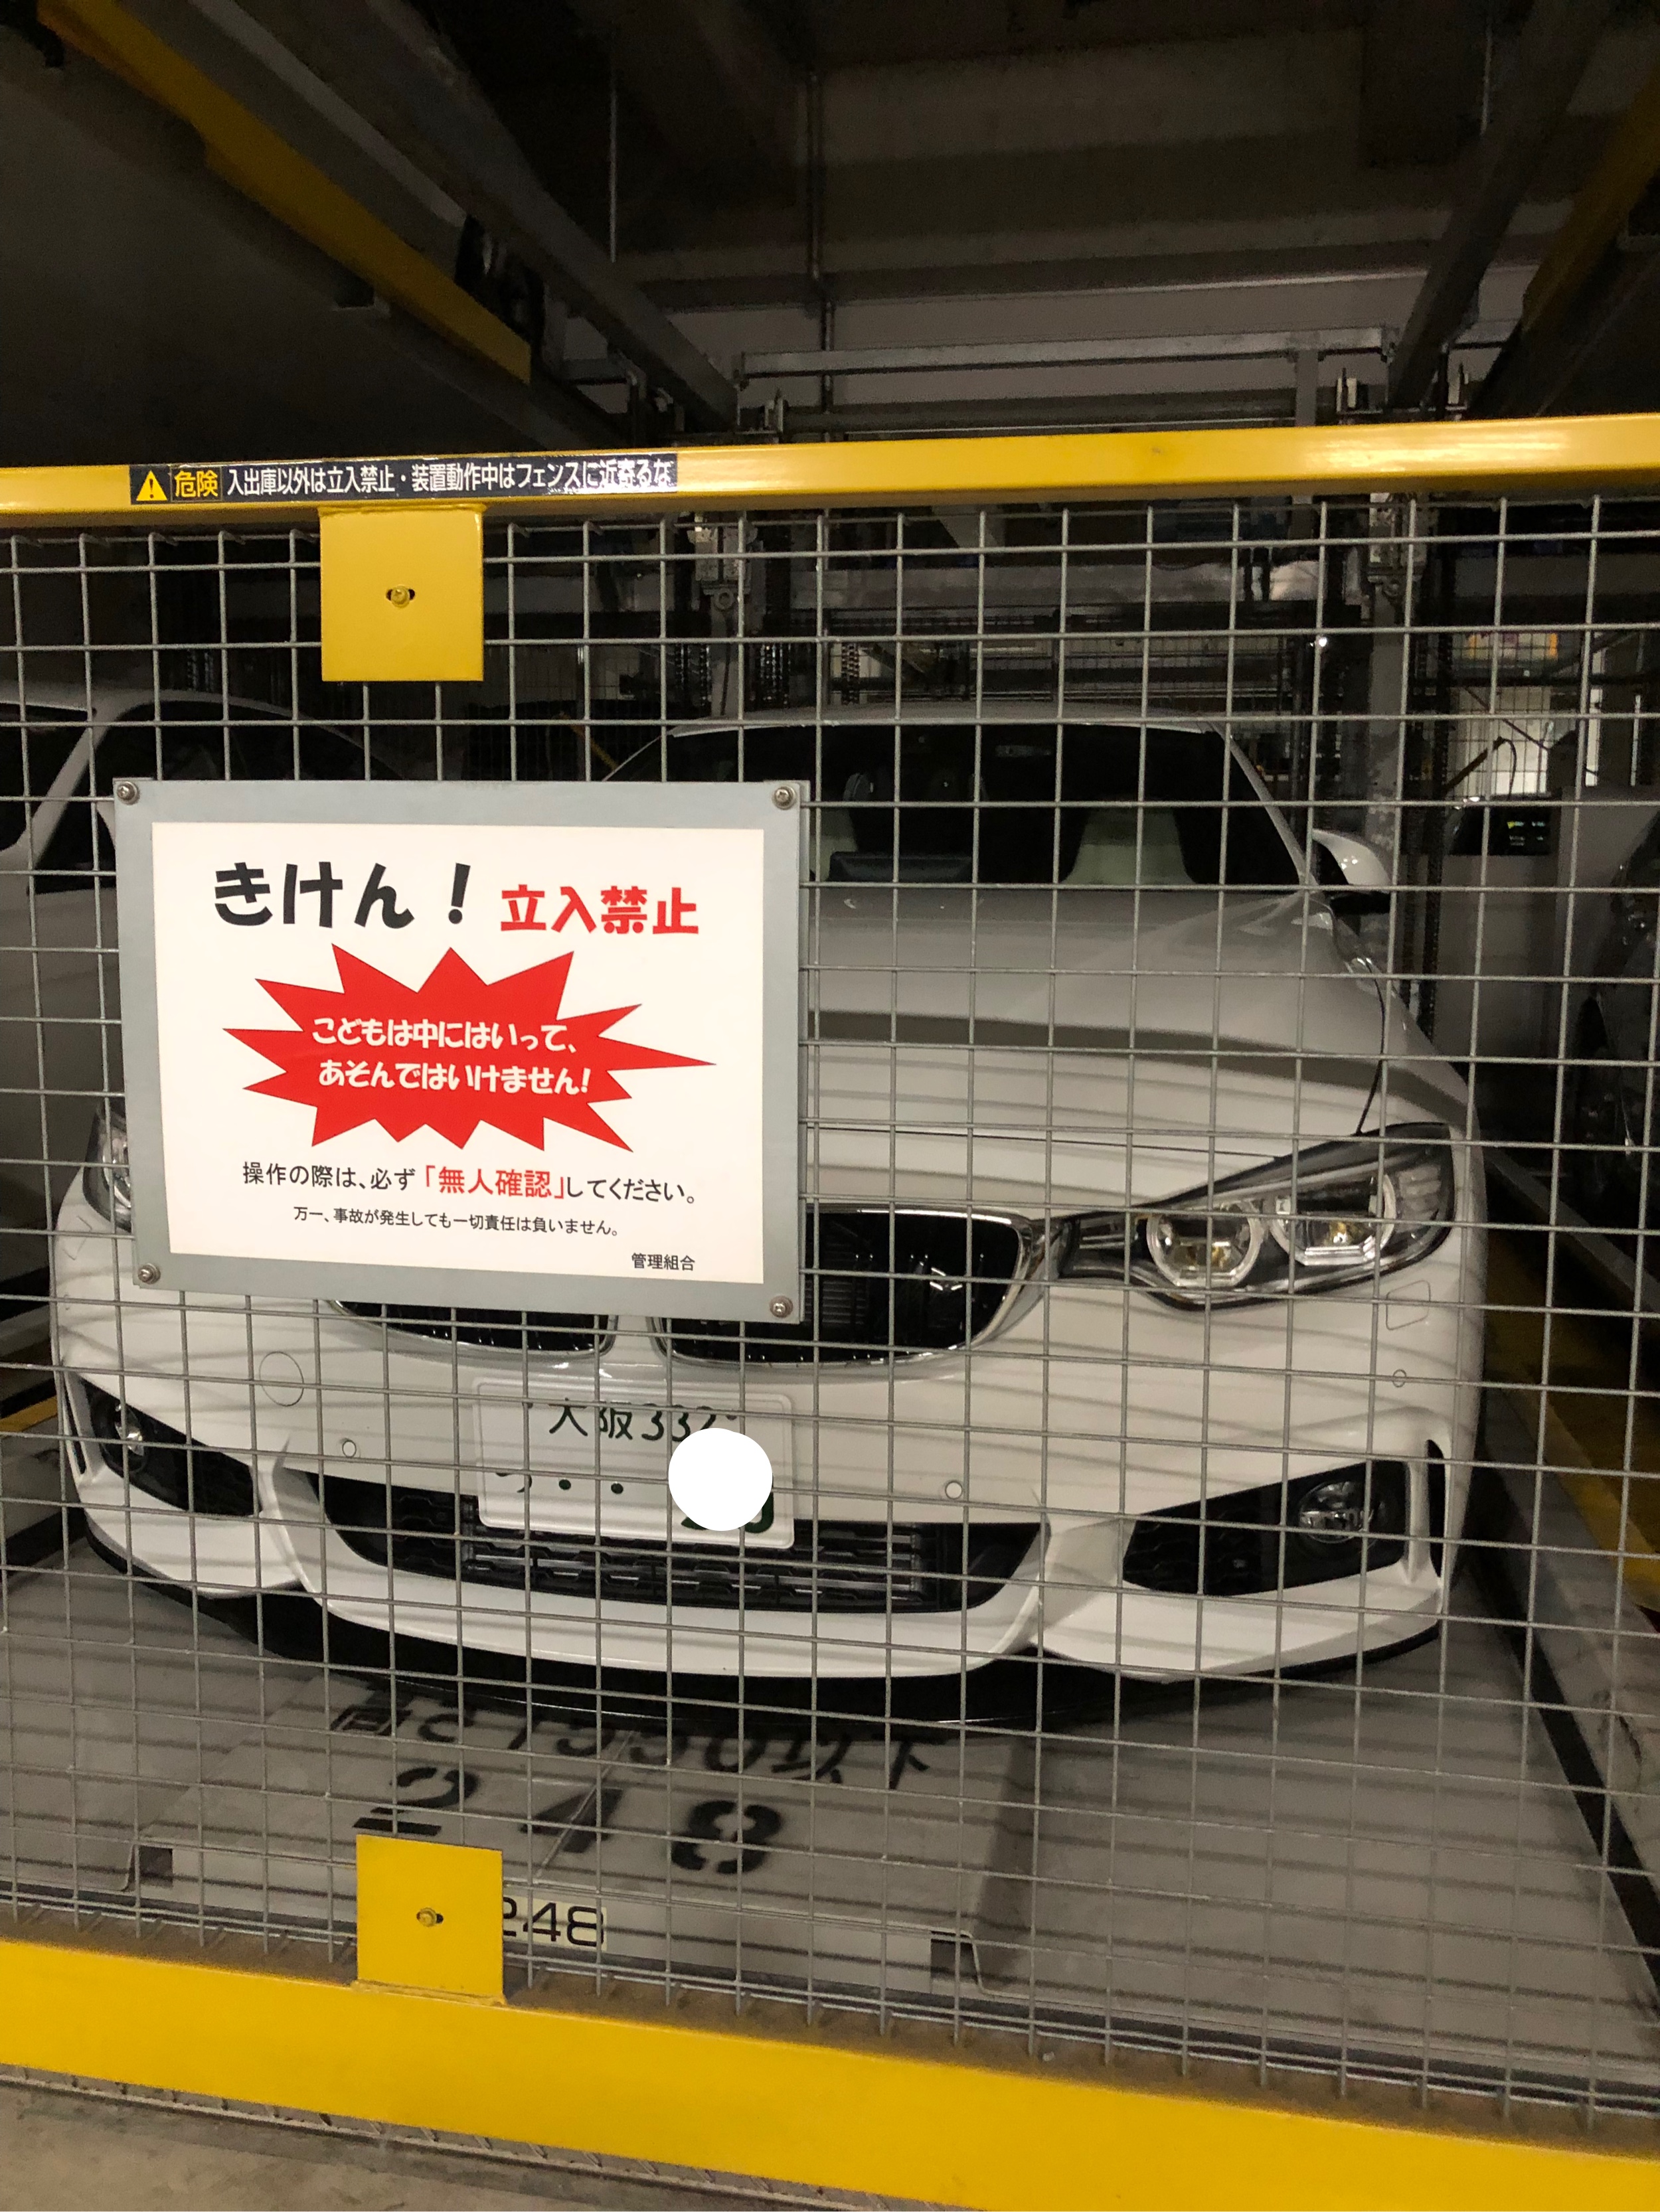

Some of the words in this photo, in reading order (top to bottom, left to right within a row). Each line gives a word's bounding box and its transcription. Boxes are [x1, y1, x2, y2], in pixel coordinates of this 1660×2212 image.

[174, 469, 218, 498] 危険
[214, 861, 471, 929] きけん！
[500, 884, 699, 935] 立入禁止
[312, 1018, 576, 1053] こどもは中にはいって、
[319, 1060, 591, 1095] あそんではいけません!
[293, 1206, 618, 1237] 万一、事故が発生しても一切責任は負いません。
[631, 1253, 696, 1271] 管理組合
[353, 1766, 783, 1875] 248
